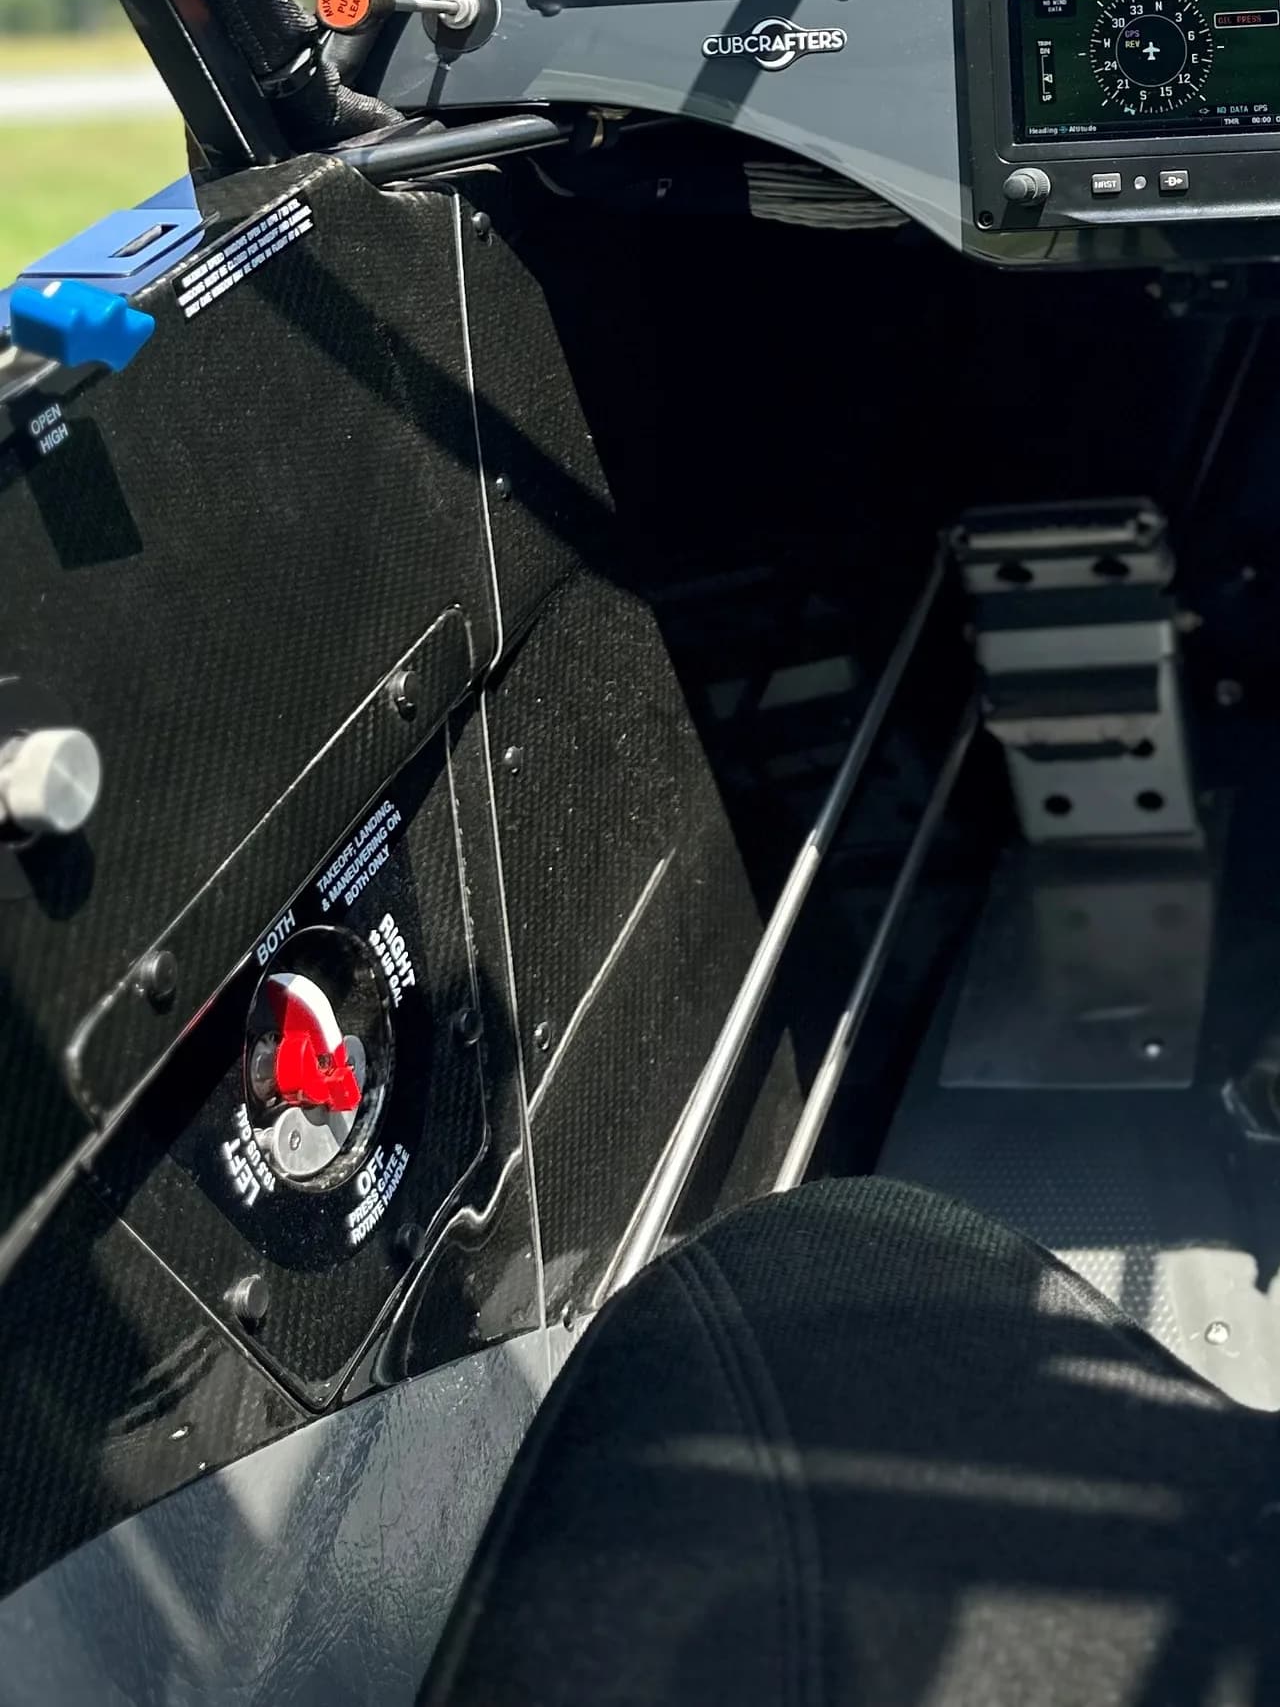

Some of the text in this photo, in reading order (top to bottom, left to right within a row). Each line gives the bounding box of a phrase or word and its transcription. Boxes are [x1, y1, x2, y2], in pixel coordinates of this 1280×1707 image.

[1112, 18, 1125, 28] 30
[1130, 6, 1143, 15] 33
[703, 29, 845, 56] CUBCRAFTERS
[1104, 61, 1117, 70] 24
[1178, 74, 1191, 84] 12
[1117, 79, 1130, 89] 21
[1160, 87, 1172, 96] 15
[30, 403, 62, 435] OPEN
[40, 423, 68, 454] HIGH
[322, 810, 401, 912] & MANEUVERING ON
[344, 844, 390, 906] BOTH ONLY
[256, 909, 295, 966] BOTH
[379, 913, 415, 987] RIGHT
[222, 1138, 260, 1206] LEFT
[357, 1146, 385, 1197] OFF
[347, 1189, 379, 1228] PRESS
[377, 1155, 398, 1191] GATE
[350, 1148, 410, 1245] ROTATE HANDLE
